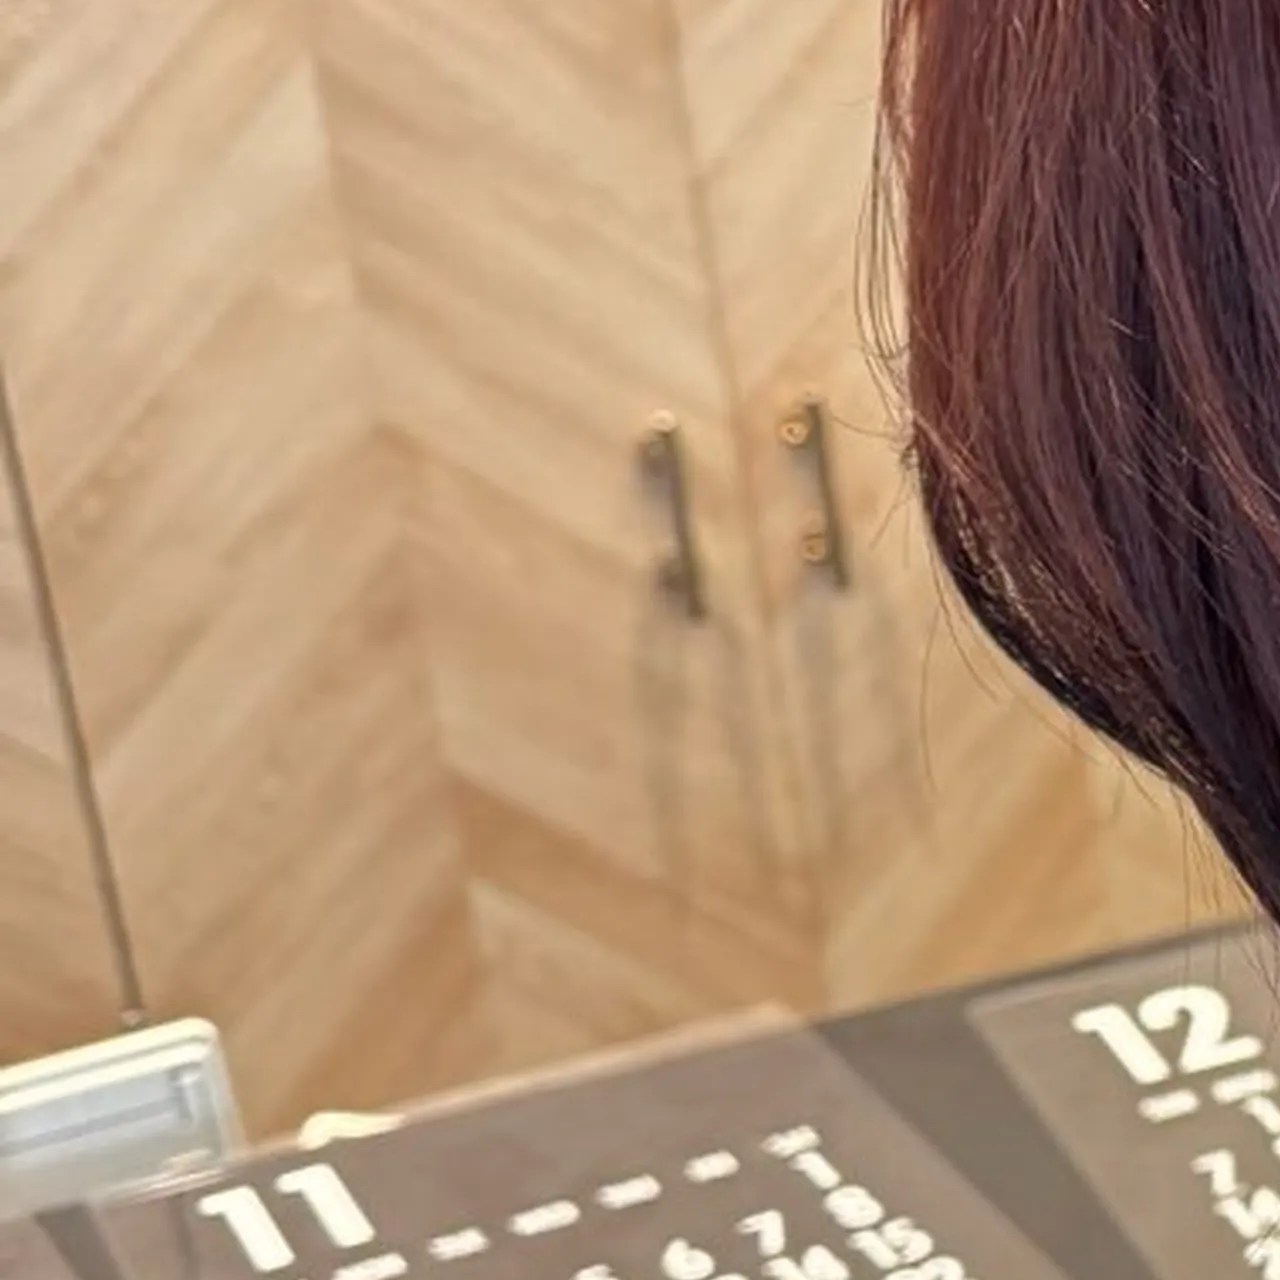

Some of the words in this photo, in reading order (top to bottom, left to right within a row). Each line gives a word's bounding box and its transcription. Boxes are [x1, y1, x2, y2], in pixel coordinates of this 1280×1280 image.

[1072, 984, 1264, 1085] 12
[788, 1150, 841, 1190] 1
[1189, 1149, 1237, 1197] 7
[196, 1162, 376, 1272] 11
[734, 1209, 785, 1258] 7
[823, 1184, 885, 1230] 8
[847, 1216, 934, 1270] 15
